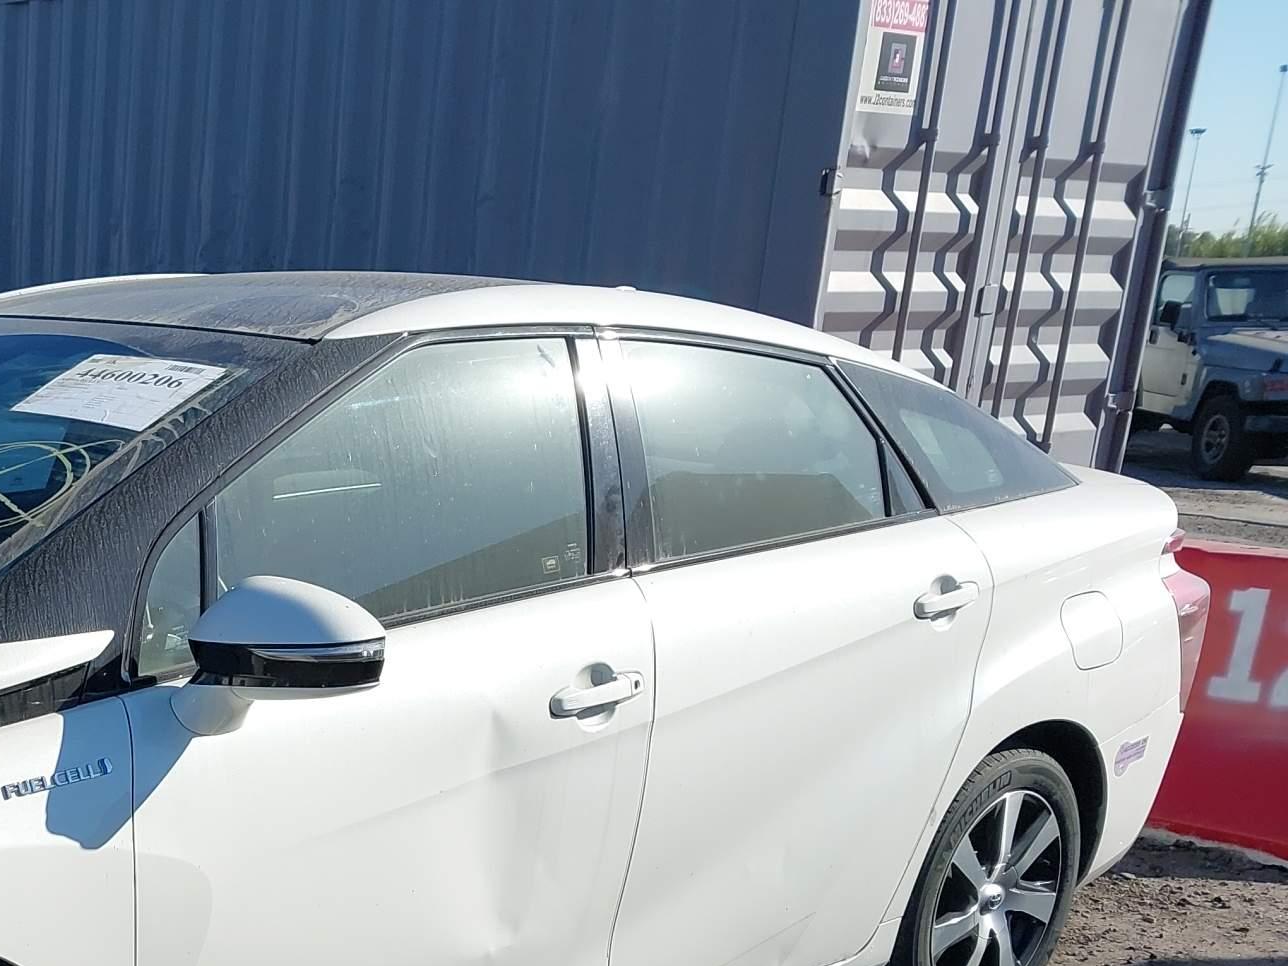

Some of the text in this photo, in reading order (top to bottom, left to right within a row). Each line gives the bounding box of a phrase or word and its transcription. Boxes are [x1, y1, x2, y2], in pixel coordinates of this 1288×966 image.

[75, 366, 187, 389] 44600206
[0, 763, 104, 801] FUEL CELL
